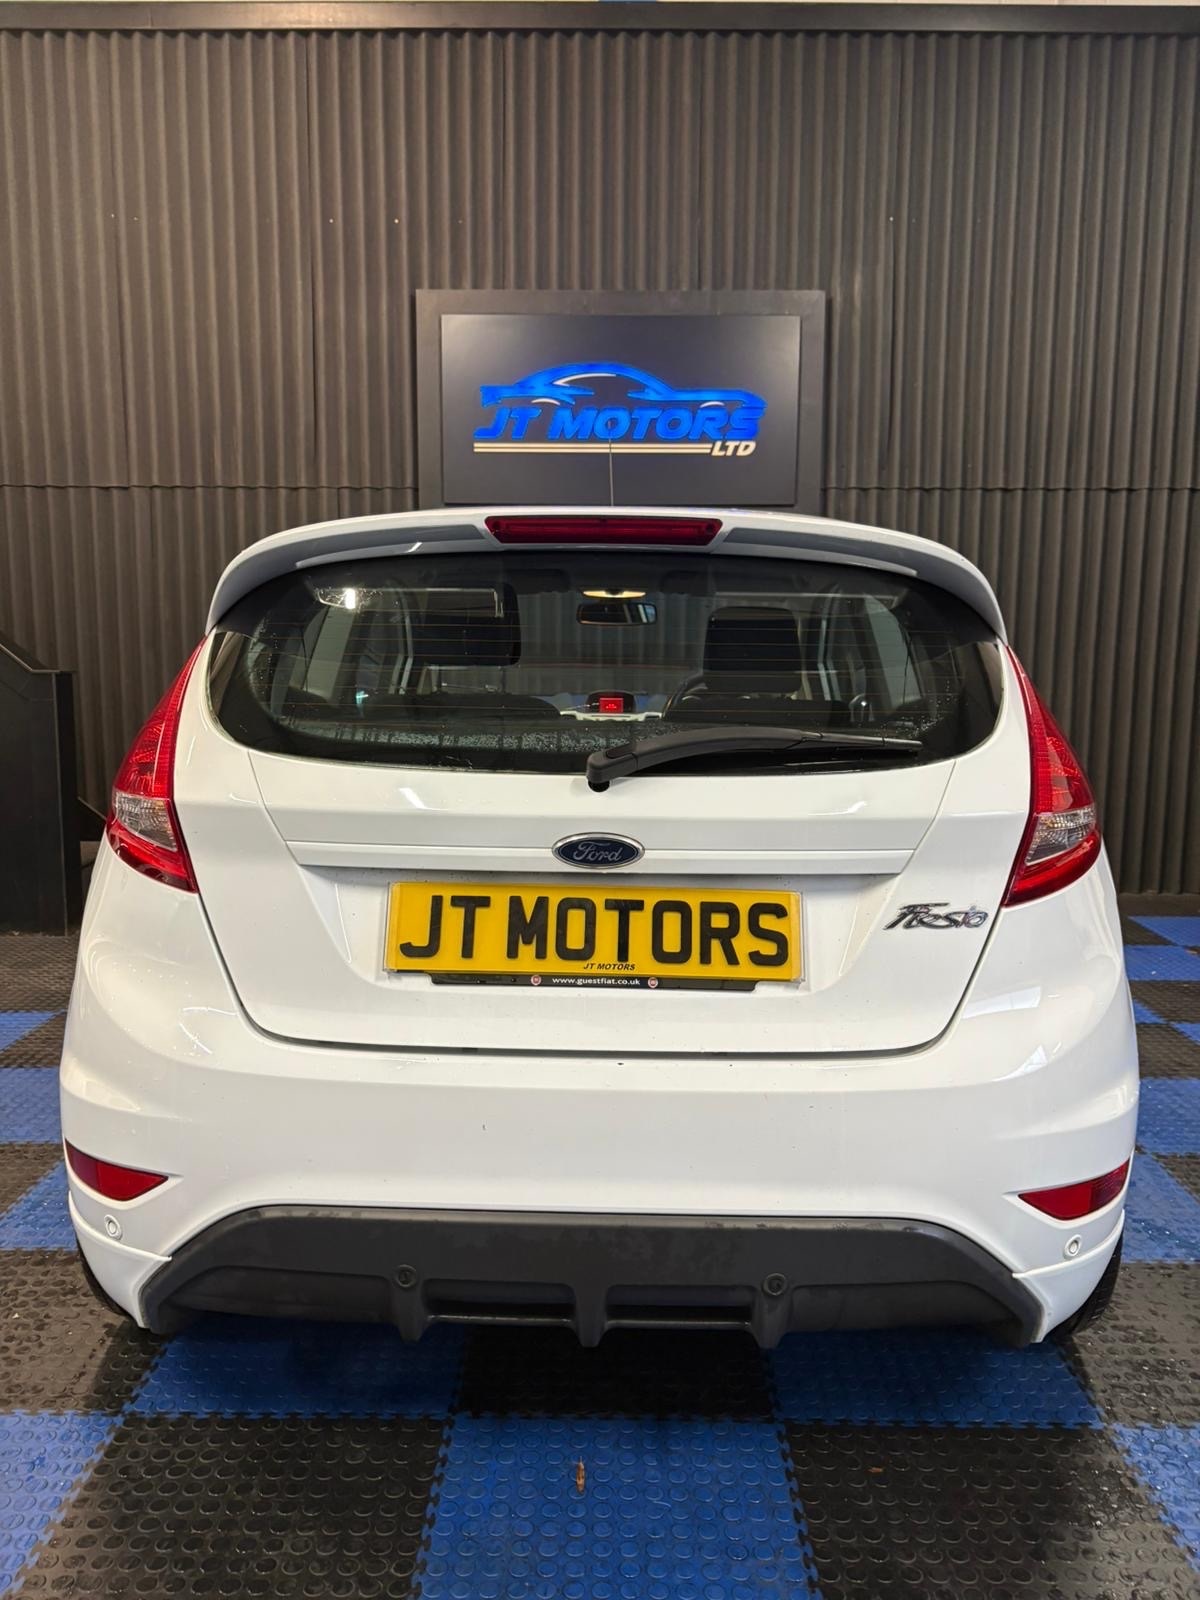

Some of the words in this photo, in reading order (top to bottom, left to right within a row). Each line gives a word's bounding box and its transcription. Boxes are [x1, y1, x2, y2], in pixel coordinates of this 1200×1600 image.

[473, 407, 541, 439] JT
[548, 407, 764, 440] MOTORS
[711, 441, 756, 456] LTD
[573, 841, 623, 861] Ford
[400, 895, 491, 958] JT
[506, 896, 789, 966] MOTORS
[597, 963, 635, 971] MOTORS
[552, 977, 641, 985] www.guestfiat.co.uk
